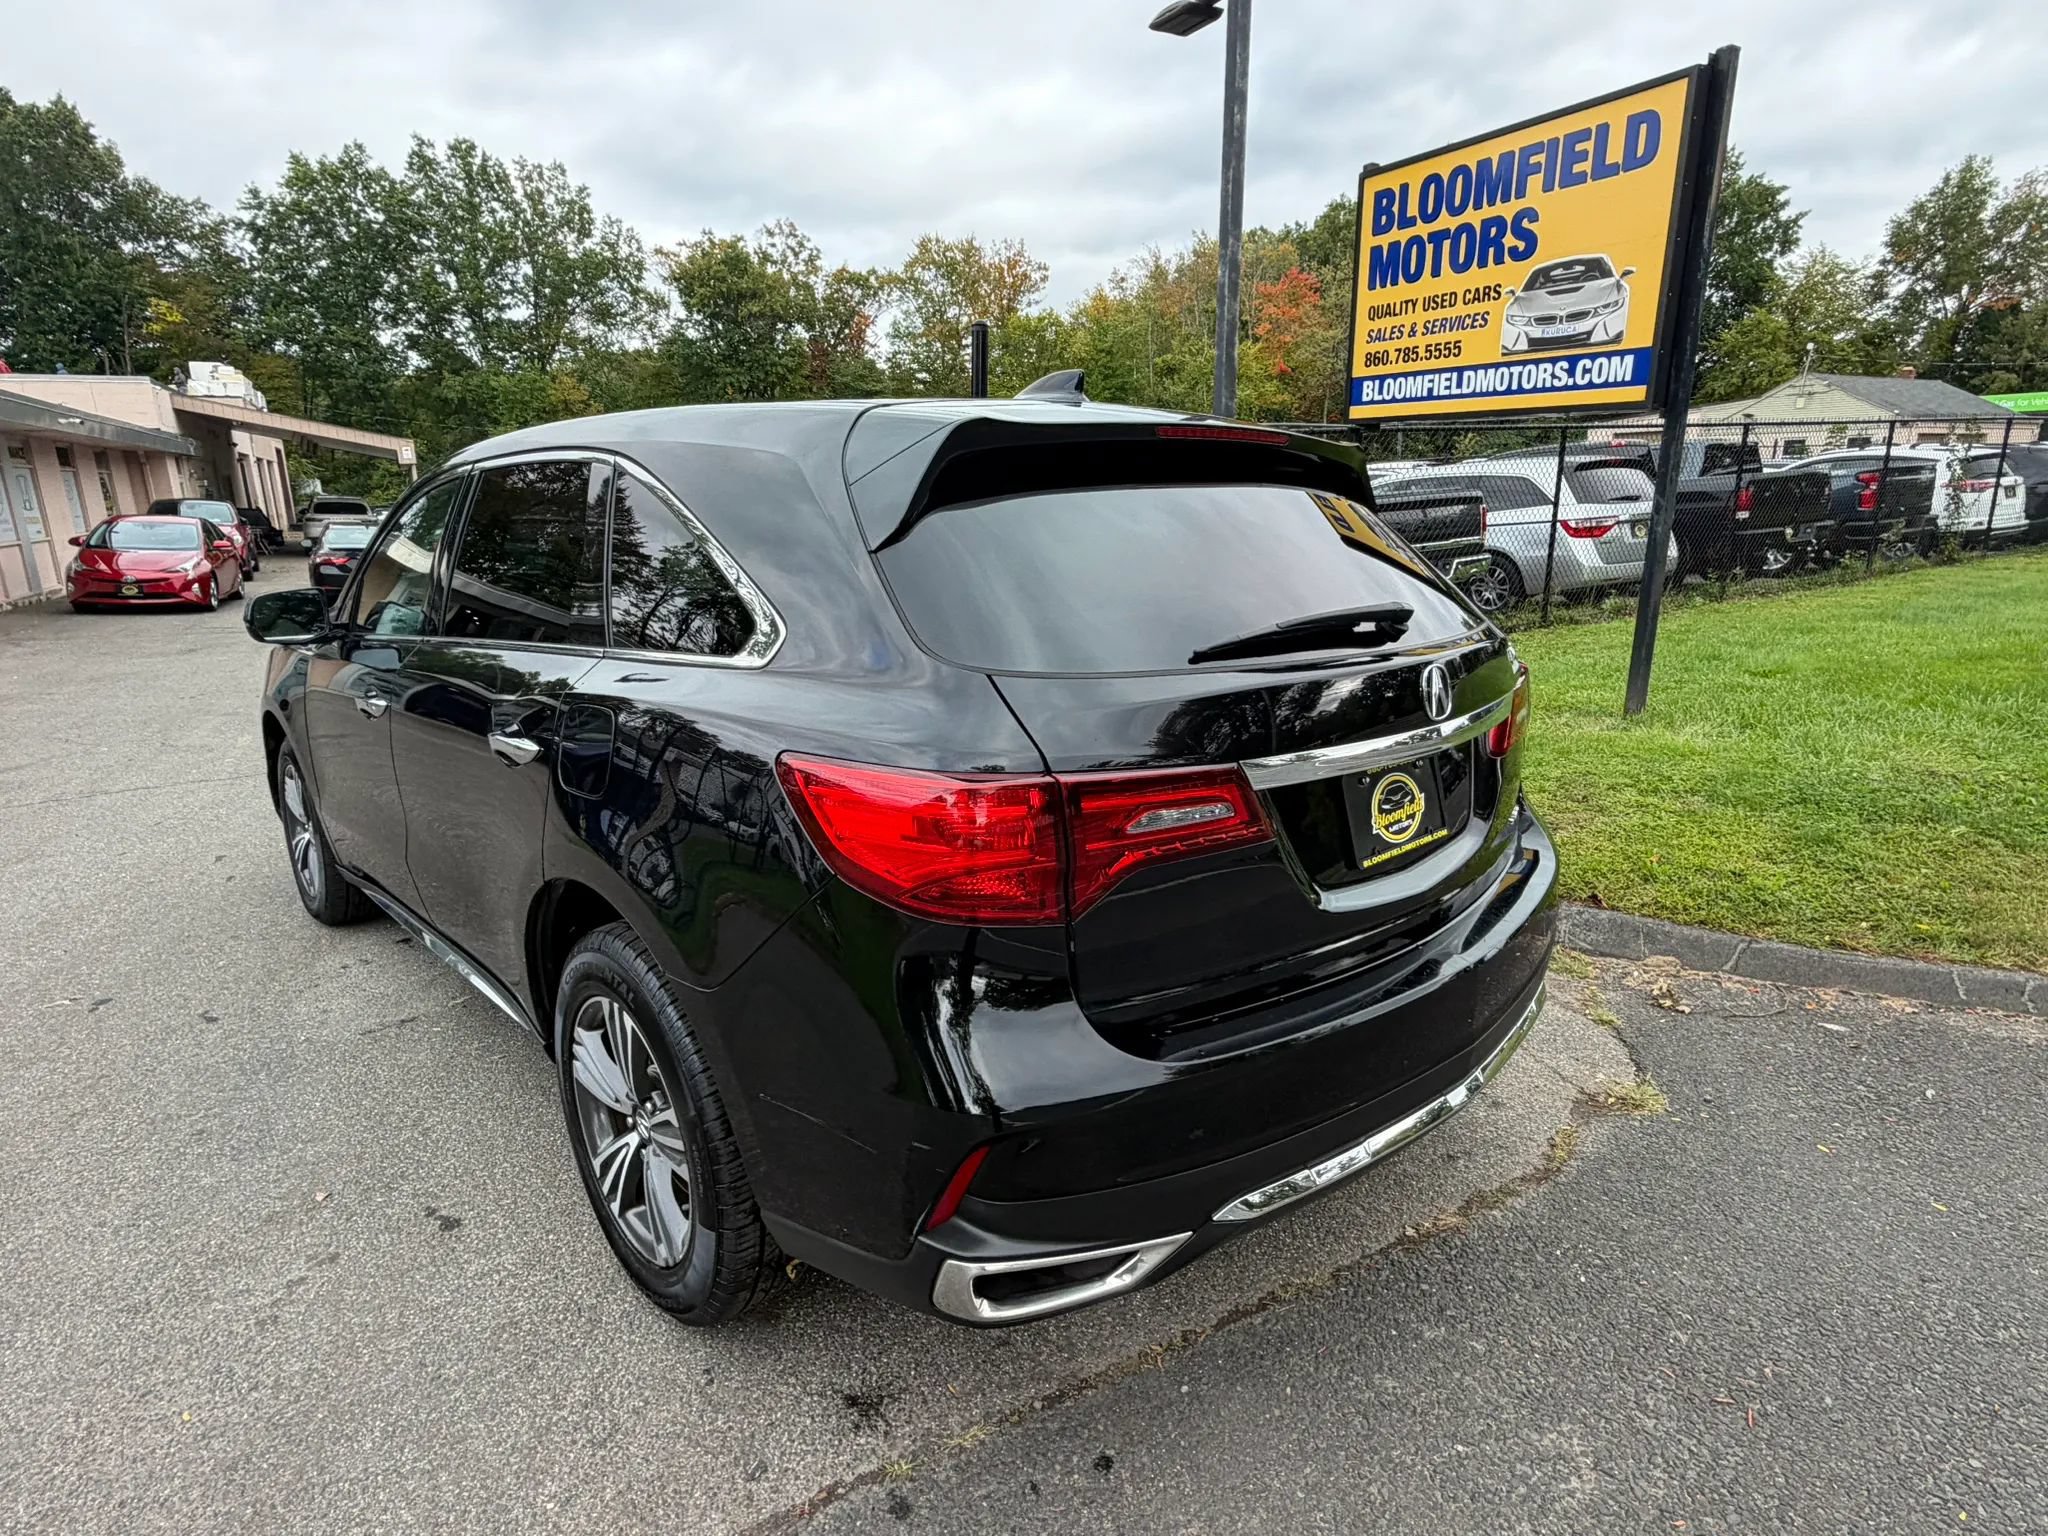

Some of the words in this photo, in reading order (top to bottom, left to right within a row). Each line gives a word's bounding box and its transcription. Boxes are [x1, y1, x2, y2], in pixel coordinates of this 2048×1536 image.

[1372, 109, 1661, 237] BLOOMFIELD
[1368, 207, 1540, 291] MOTORS
[1368, 298, 1419, 321] QUALITY
[1422, 291, 1458, 312] USED
[1463, 283, 1502, 306] CARS
[1366, 324, 1405, 344] SALES
[1408, 322, 1418, 338] &
[1421, 311, 1490, 336] SERVICES
[1364, 340, 1462, 368] 860.785.5555
[1361, 354, 1635, 402] BLOOMFIELDMOTORS.COM
[1375, 798, 1423, 828] Bloomfield
[1362, 828, 1448, 868] BLOOMFIELDMOTORS.COM
